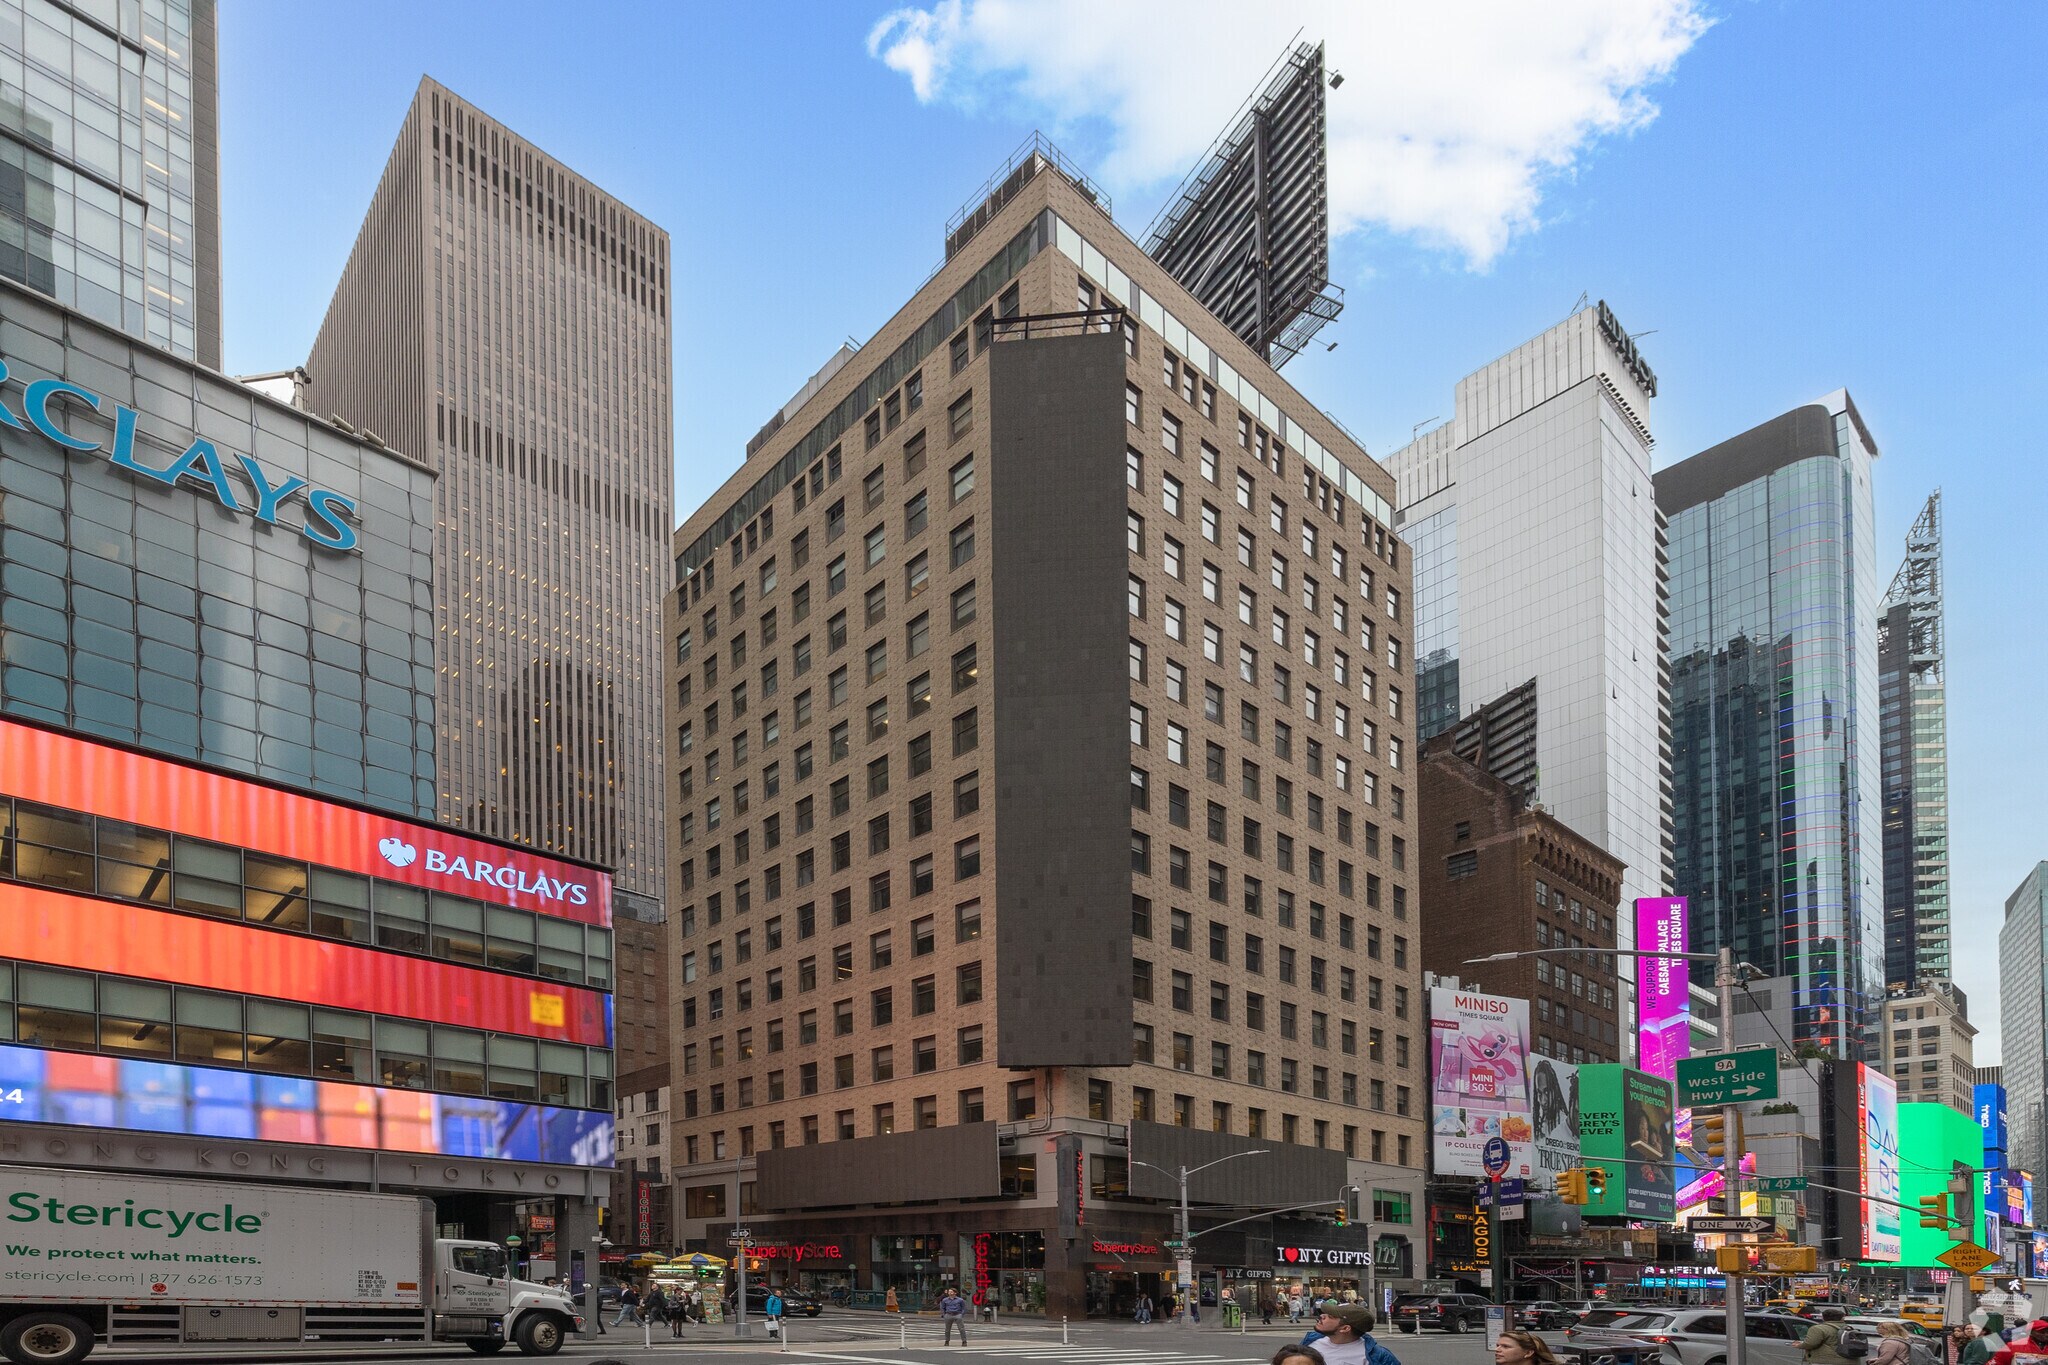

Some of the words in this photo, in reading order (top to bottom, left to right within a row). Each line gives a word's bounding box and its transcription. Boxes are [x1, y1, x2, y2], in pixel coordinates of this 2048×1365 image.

[425, 848, 588, 906] BARCLAYS
[1670, 903, 1682, 940] SQUARE
[1657, 919, 1669, 952] PALACE
[1671, 940, 1682, 967] TIES
[1455, 995, 1509, 1014] MINISO
[1646, 996, 1657, 1010] WE
[1459, 1011, 1478, 1019] TIMES
[1479, 1014, 1504, 1022] SQUARE
[1717, 1060, 1733, 1070] 9A
[1471, 1073, 1493, 1083] MINI
[1629, 1077, 1652, 1094] Stream
[1653, 1084, 1666, 1098] with
[1688, 1075, 1725, 1088] West
[1731, 1071, 1766, 1083] Side
[1629, 1090, 1644, 1102] your
[1644, 1094, 1667, 1109] person.
[1691, 1090, 1723, 1101] Hwy
[2, 1134, 157, 1161] HONG
[198, 1147, 327, 1174] KONG
[1454, 1142, 1486, 1150] COLLECT
[410, 1163, 561, 1188] TOKYO
[1760, 1181, 1770, 1190] W
[1775, 1178, 1791, 1190] 49
[1658, 1201, 1673, 1213] hulu
[639, 1189, 650, 1246] ICHIRAN
[1736, 1221, 1761, 1229] WAY
[1473, 1205, 1489, 1257] LAGOS
[5, 1244, 41, 1257] We
[48, 1248, 125, 1260] protect
[131, 1250, 180, 1262] what
[185, 1252, 262, 1265] matters.
[1277, 1246, 1285, 1262] I
[1327, 1250, 1372, 1266] GIFTS
[4, 1270, 135, 1286] stericycle.com
[150, 1273, 180, 1285] 877
[187, 1274, 263, 1286] 626-1573
[971, 1232, 992, 1306] Superdry
[1246, 1269, 1272, 1278] GIFTS
